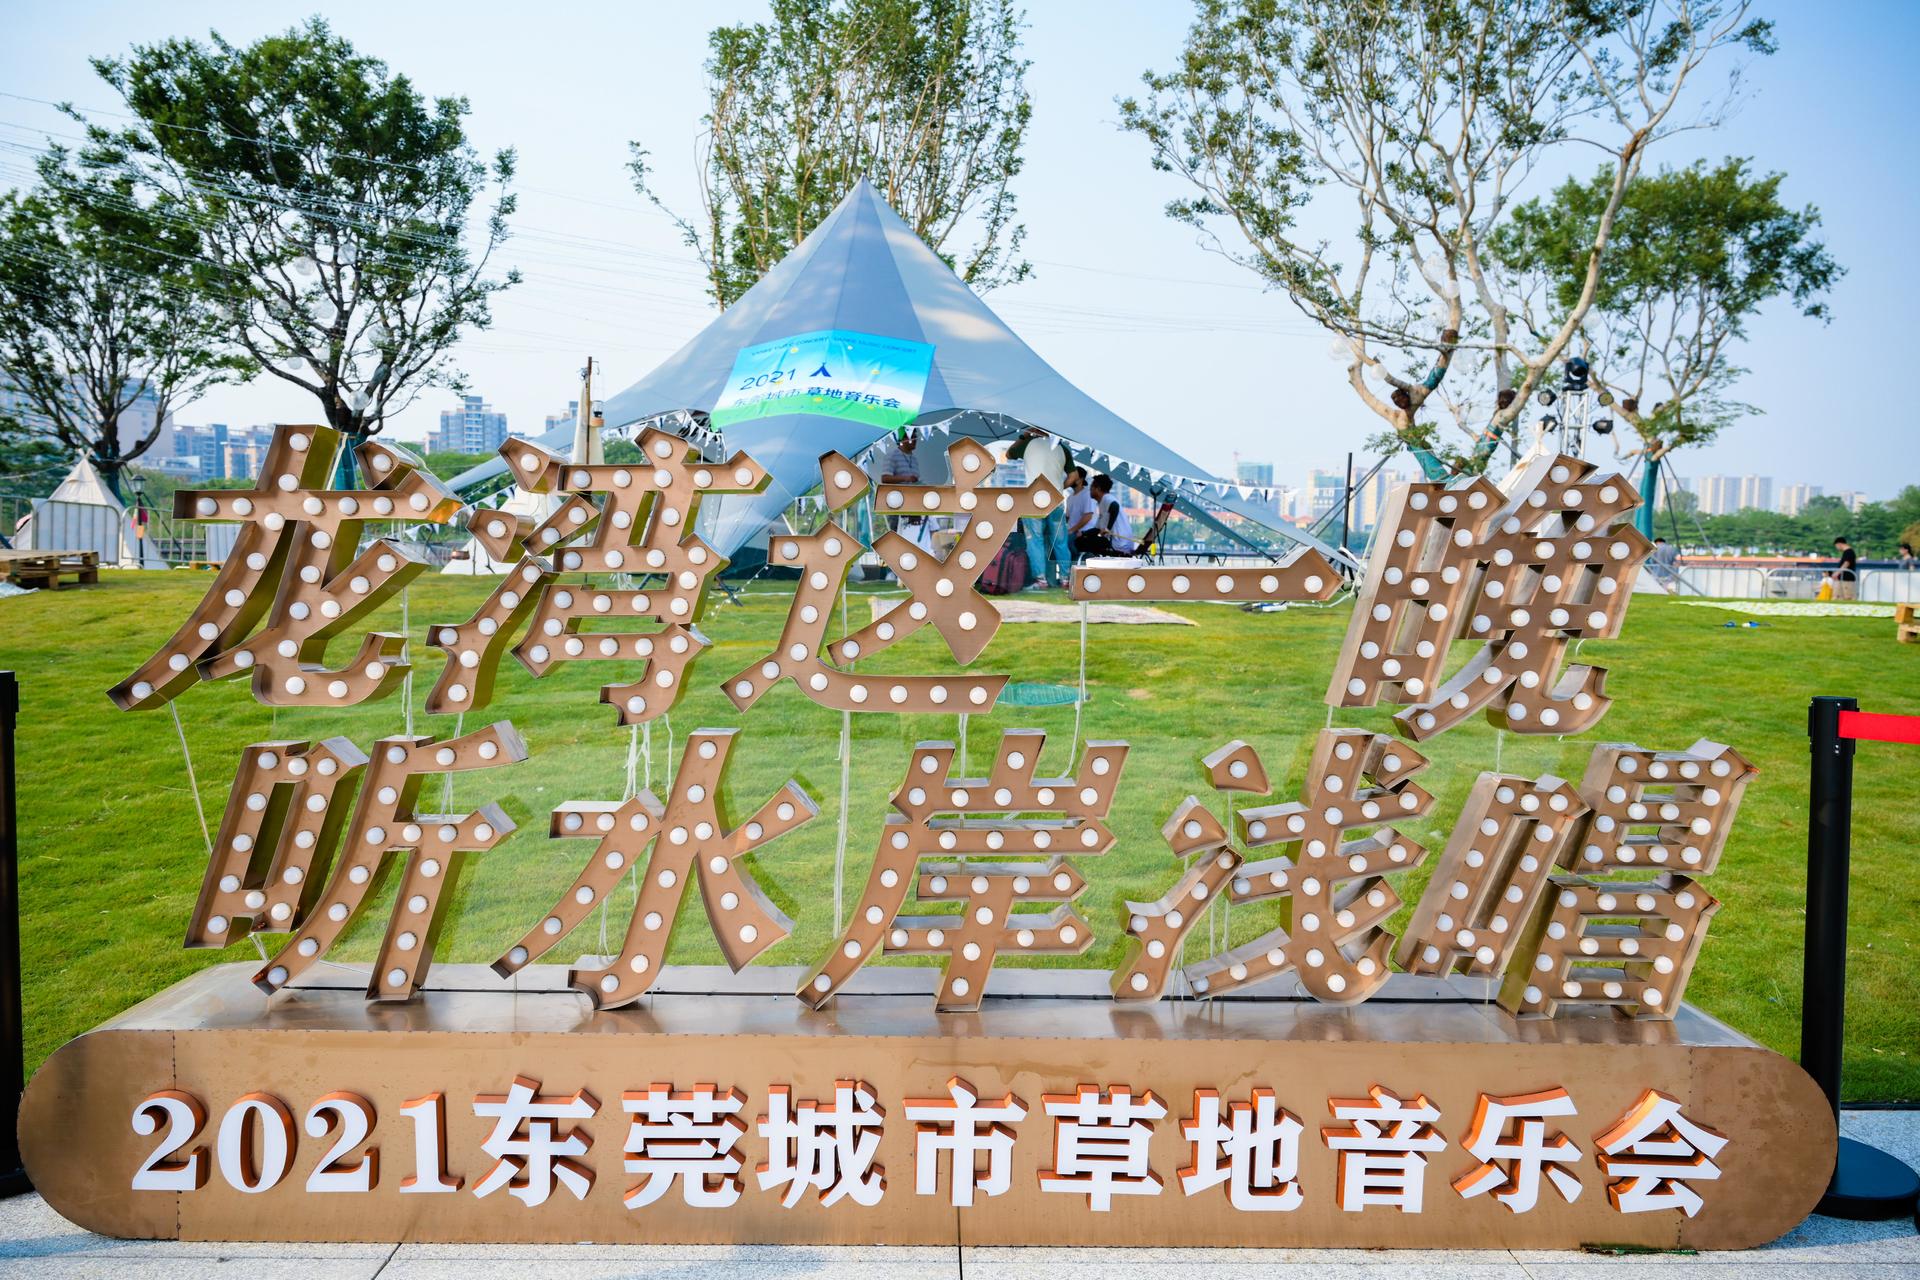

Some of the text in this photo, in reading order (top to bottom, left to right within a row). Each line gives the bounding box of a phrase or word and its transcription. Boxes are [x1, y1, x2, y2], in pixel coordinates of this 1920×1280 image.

[740, 368, 796, 390] 2021
[108, 424, 1655, 741] 龙湾这一晚
[184, 721, 1758, 1020] 听水岸浅唱
[131, 1075, 1728, 1218] 2021东莞城市草地音乐会
